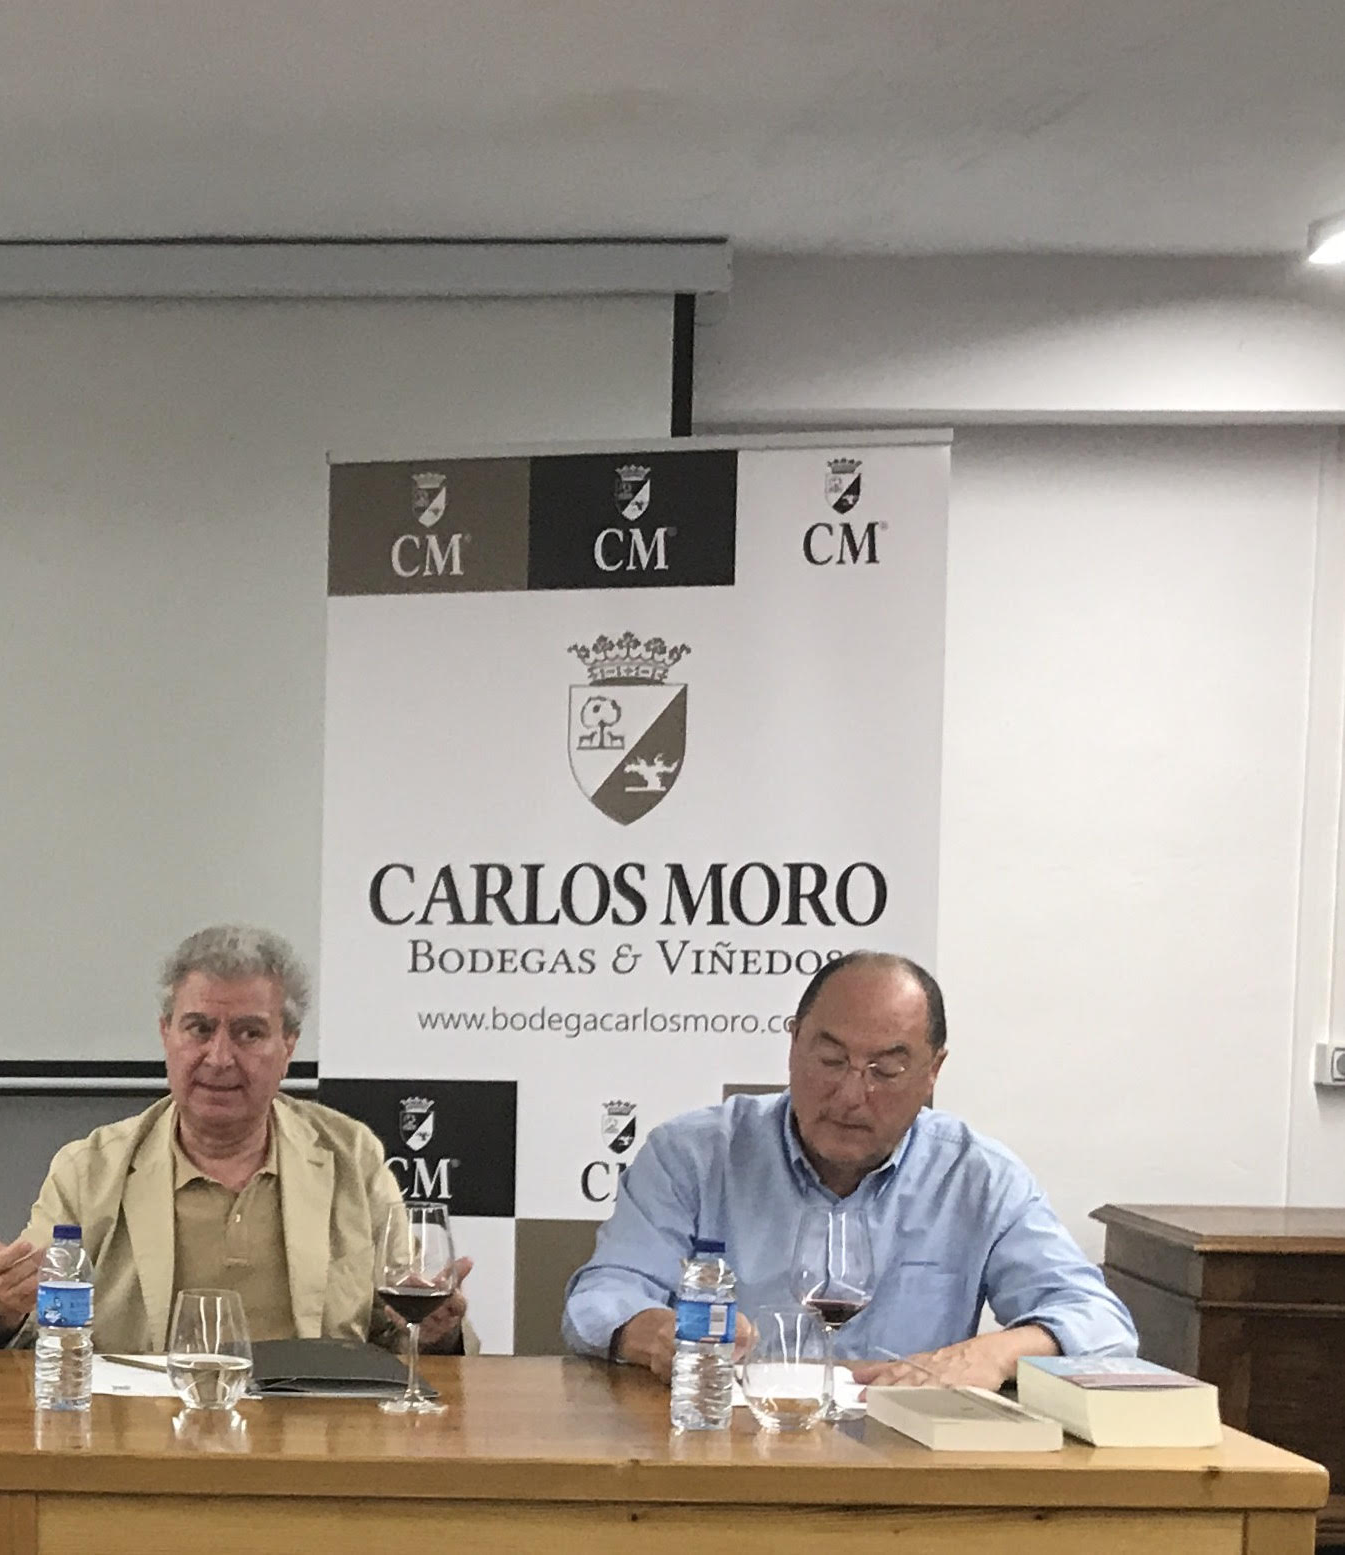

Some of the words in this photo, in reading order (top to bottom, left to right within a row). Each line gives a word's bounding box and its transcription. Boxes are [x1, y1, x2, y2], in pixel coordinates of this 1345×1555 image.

[390, 533, 465, 579] CM
[593, 527, 670, 572] CM
[802, 521, 880, 566] CM
[368, 862, 648, 927] CARLOS
[660, 861, 889, 927] MORO
[407, 938, 596, 975] BODEGAS
[611, 942, 642, 975] &
[417, 1006, 797, 1038] www.bodegacarlosmoro.co
[581, 1160, 627, 1203] C
